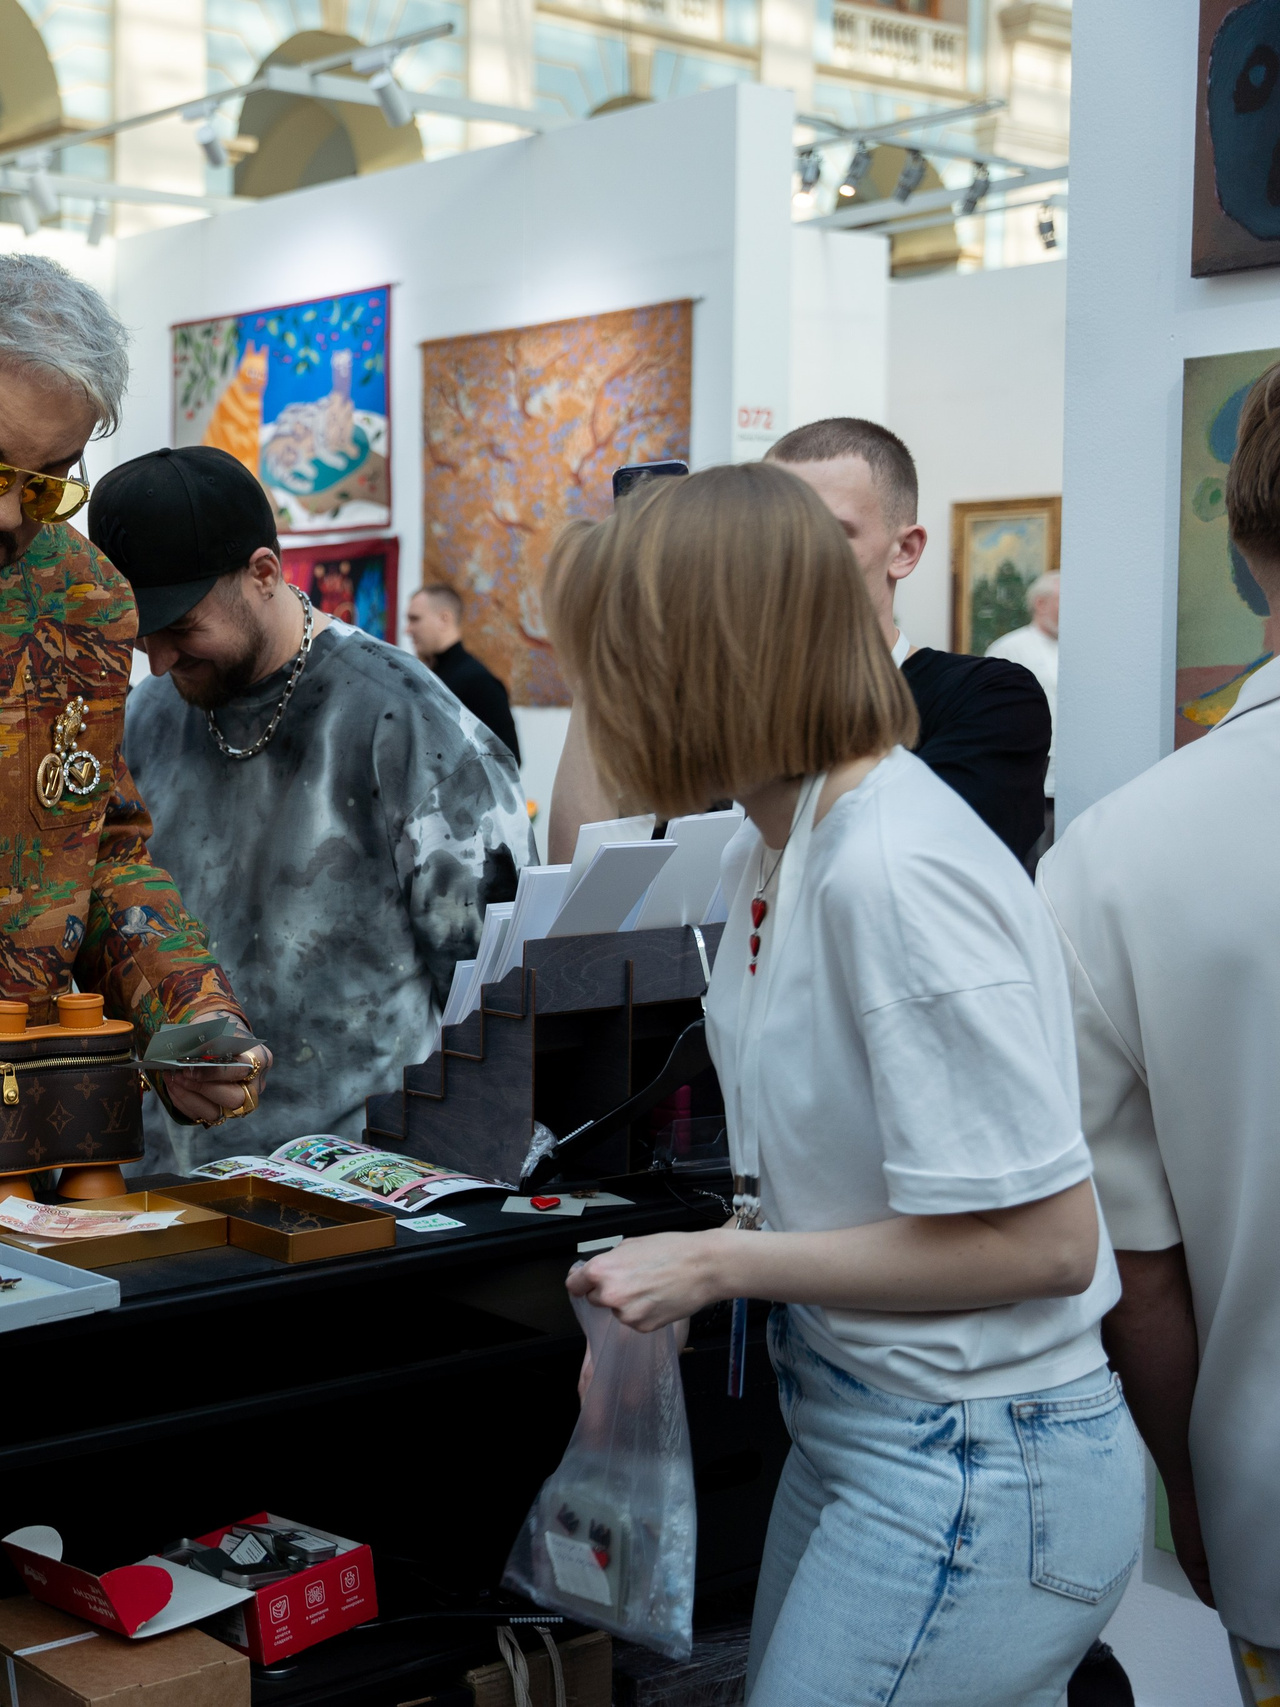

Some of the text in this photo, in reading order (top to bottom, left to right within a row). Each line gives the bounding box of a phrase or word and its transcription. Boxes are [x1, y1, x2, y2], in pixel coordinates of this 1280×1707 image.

[737, 406, 774, 431] D72
[72, 1587, 109, 1609] HEALTHY
[88, 1602, 116, 1620] HAPPY
[273, 1635, 293, 1646] сладкого
